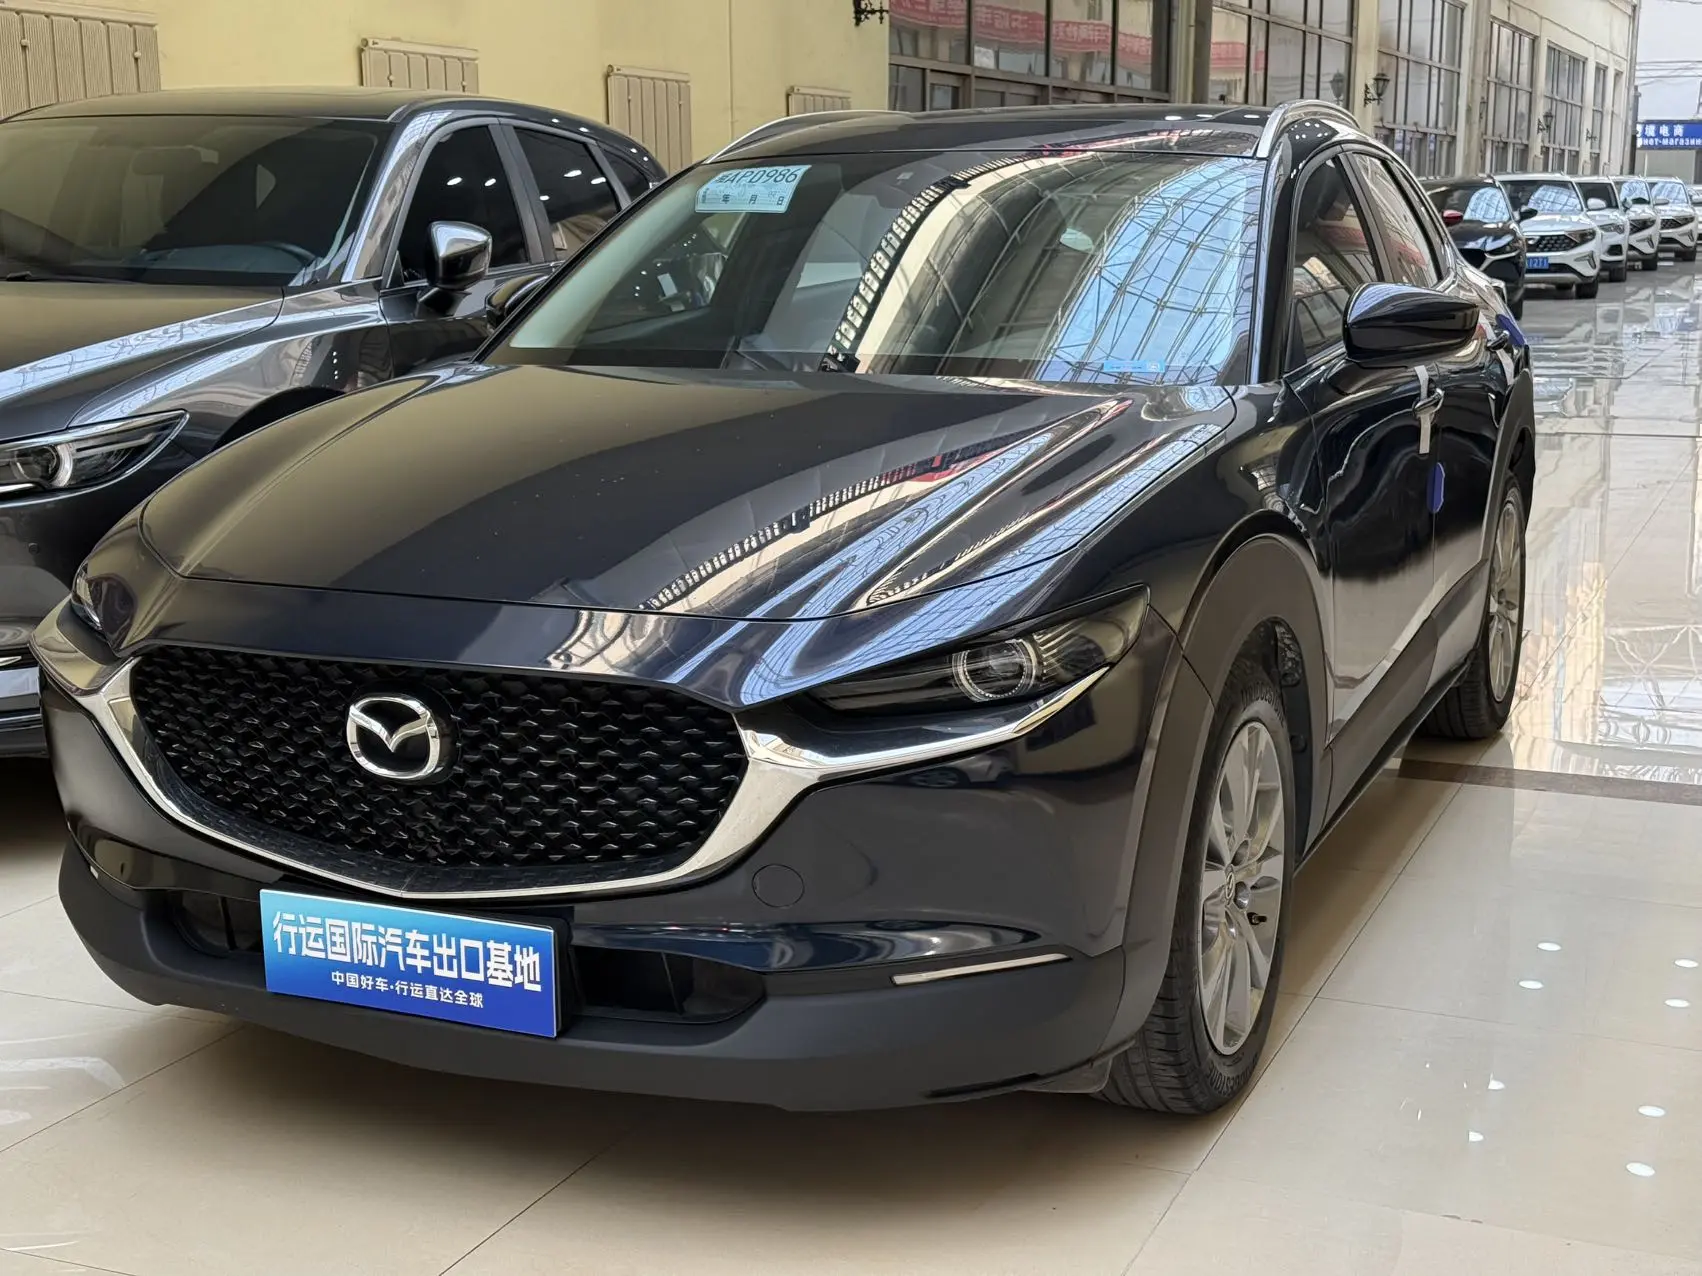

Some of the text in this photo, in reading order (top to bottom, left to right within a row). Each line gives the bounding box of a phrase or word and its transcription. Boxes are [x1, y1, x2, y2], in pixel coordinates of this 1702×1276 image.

[721, 193, 731, 205] 年
[749, 194, 758, 205] 月
[776, 196, 785, 206] 日
[272, 911, 542, 992] 行运国际汽车出口基地
[331, 971, 484, 1008] 中国好车·行运直达全球
